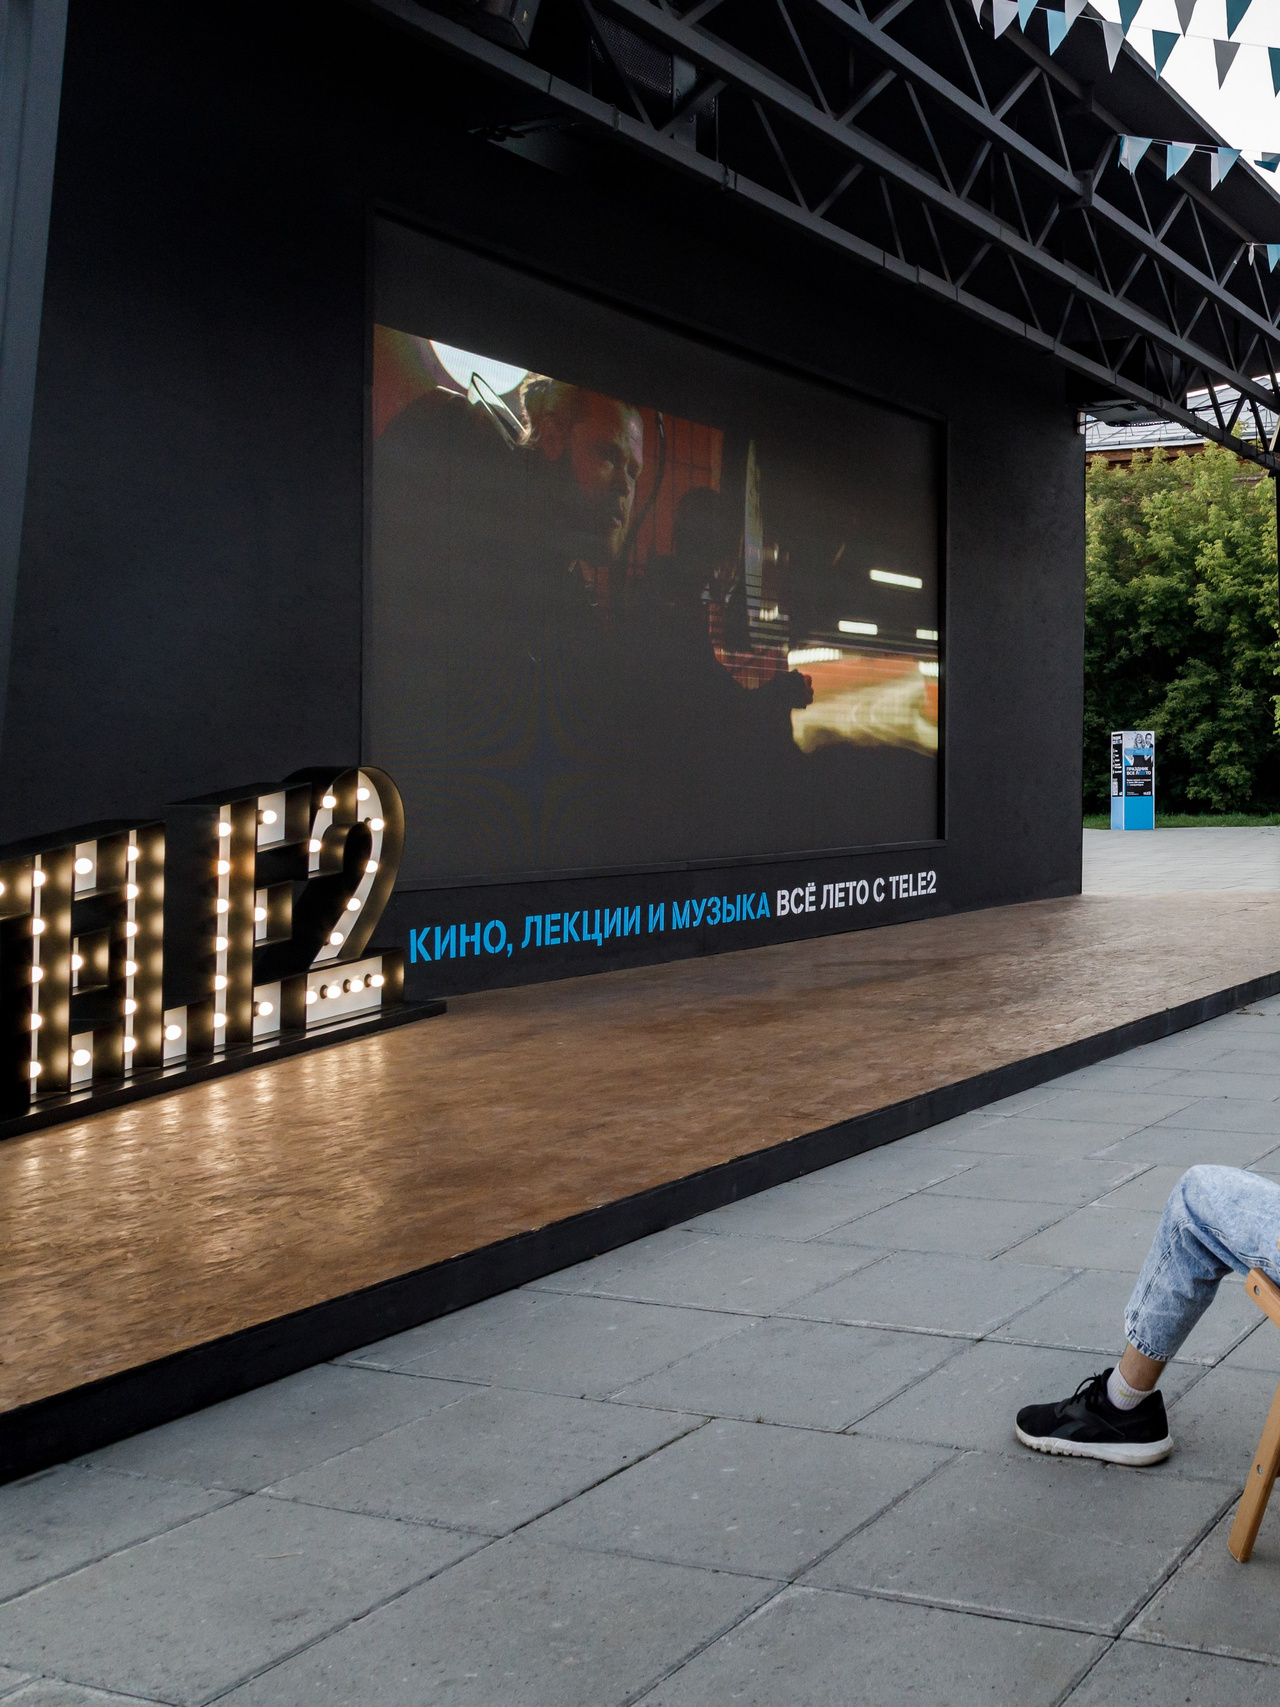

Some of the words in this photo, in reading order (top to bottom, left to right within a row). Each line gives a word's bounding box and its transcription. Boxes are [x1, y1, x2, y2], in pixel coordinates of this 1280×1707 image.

[0, 766, 405, 1105] ELE2
[410, 919, 514, 964] КИНО,
[521, 905, 641, 949] ЛЕКЦИИ
[648, 902, 665, 933] И
[672, 891, 771, 930] МУЗЫКА
[776, 882, 817, 917] ВСЁ
[820, 879, 870, 910] ЛЕТО
[872, 877, 885, 902] С
[889, 870, 937, 900] TELE2
